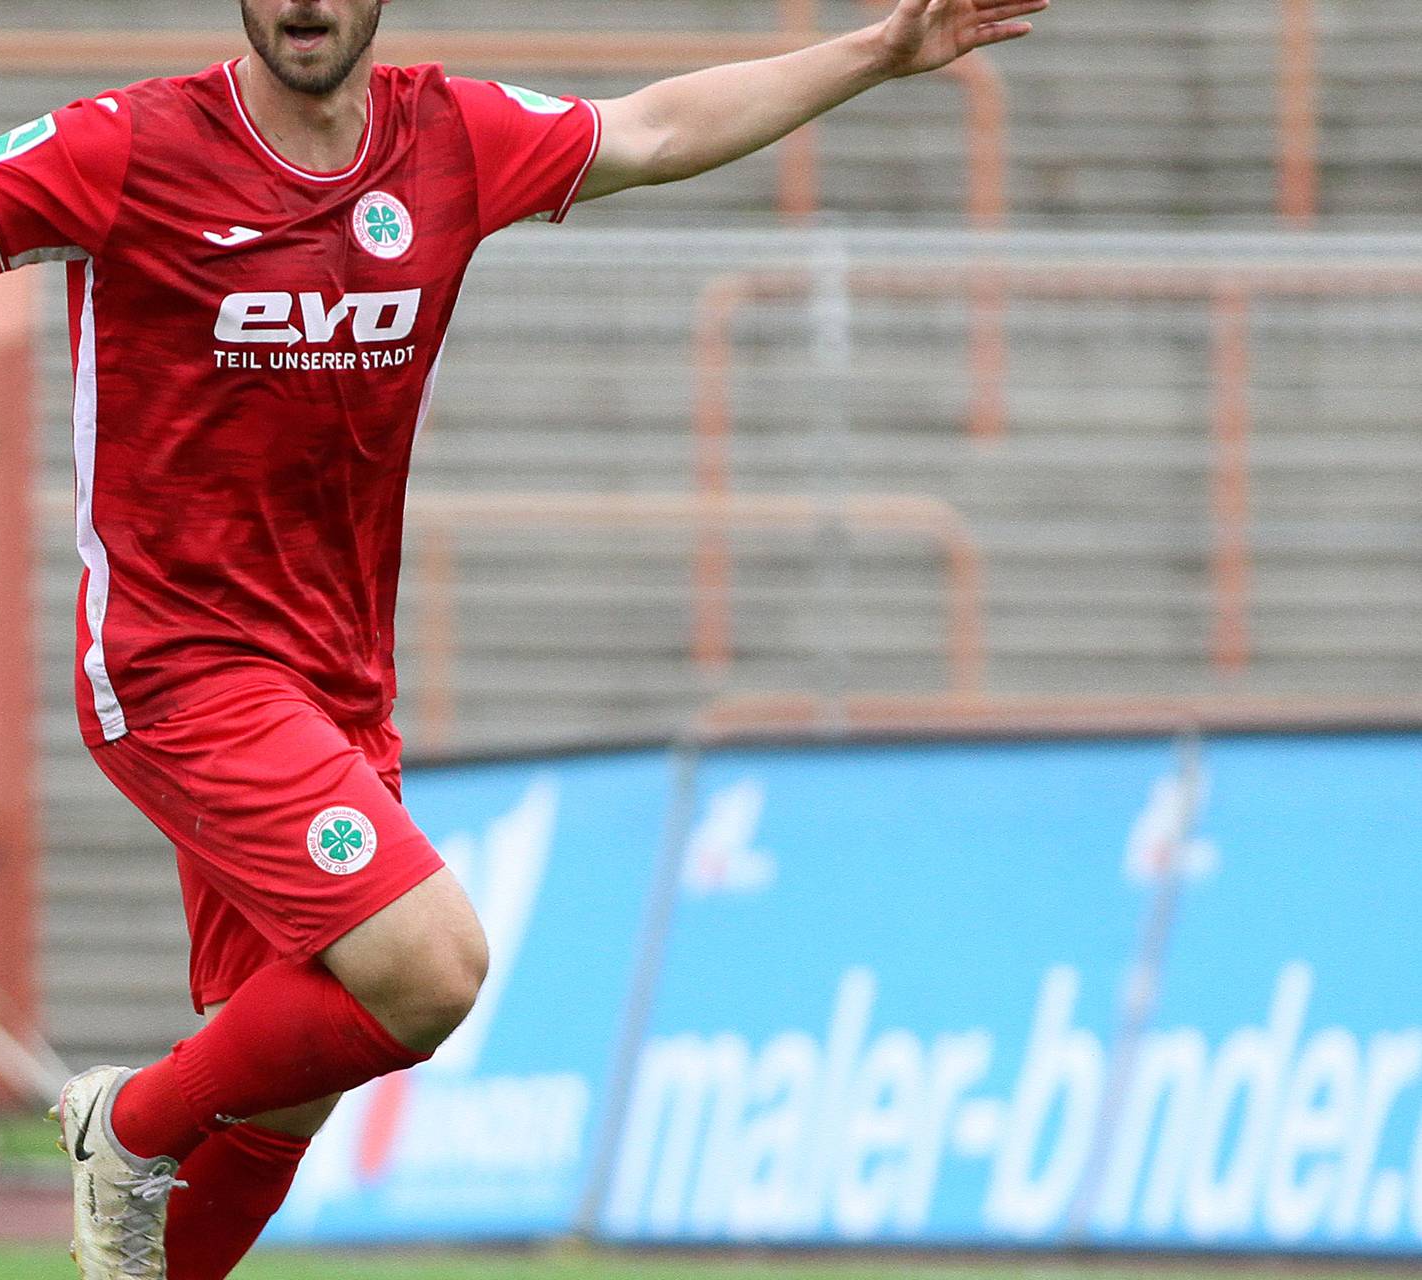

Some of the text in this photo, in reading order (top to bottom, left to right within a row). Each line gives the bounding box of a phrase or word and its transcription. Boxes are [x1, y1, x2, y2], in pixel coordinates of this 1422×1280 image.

[213, 288, 421, 347] evo
[213, 345, 415, 370] TEIL UNSERER STADT
